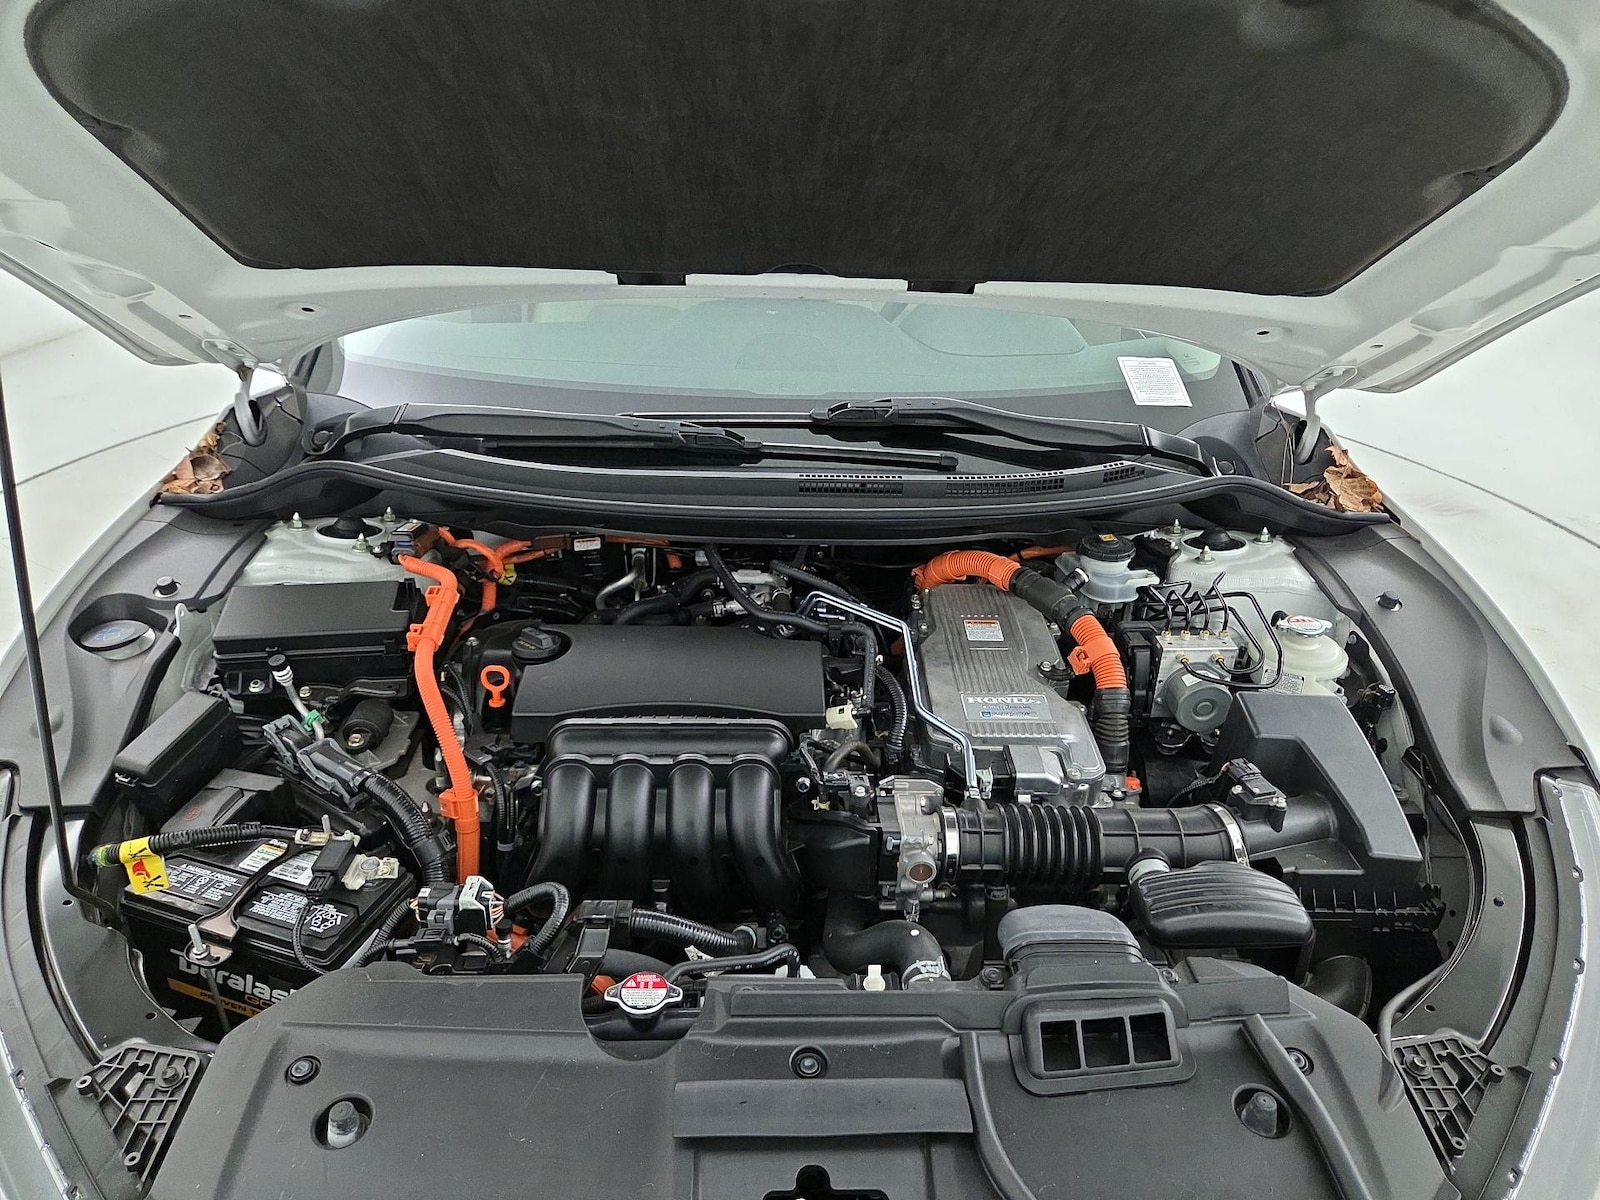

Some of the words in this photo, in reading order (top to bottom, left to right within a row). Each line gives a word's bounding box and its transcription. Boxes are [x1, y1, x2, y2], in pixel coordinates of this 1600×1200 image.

[967, 696, 1042, 704] HONDA
[178, 955, 297, 1004] Duralas
[200, 992, 247, 1013] PRVEN
